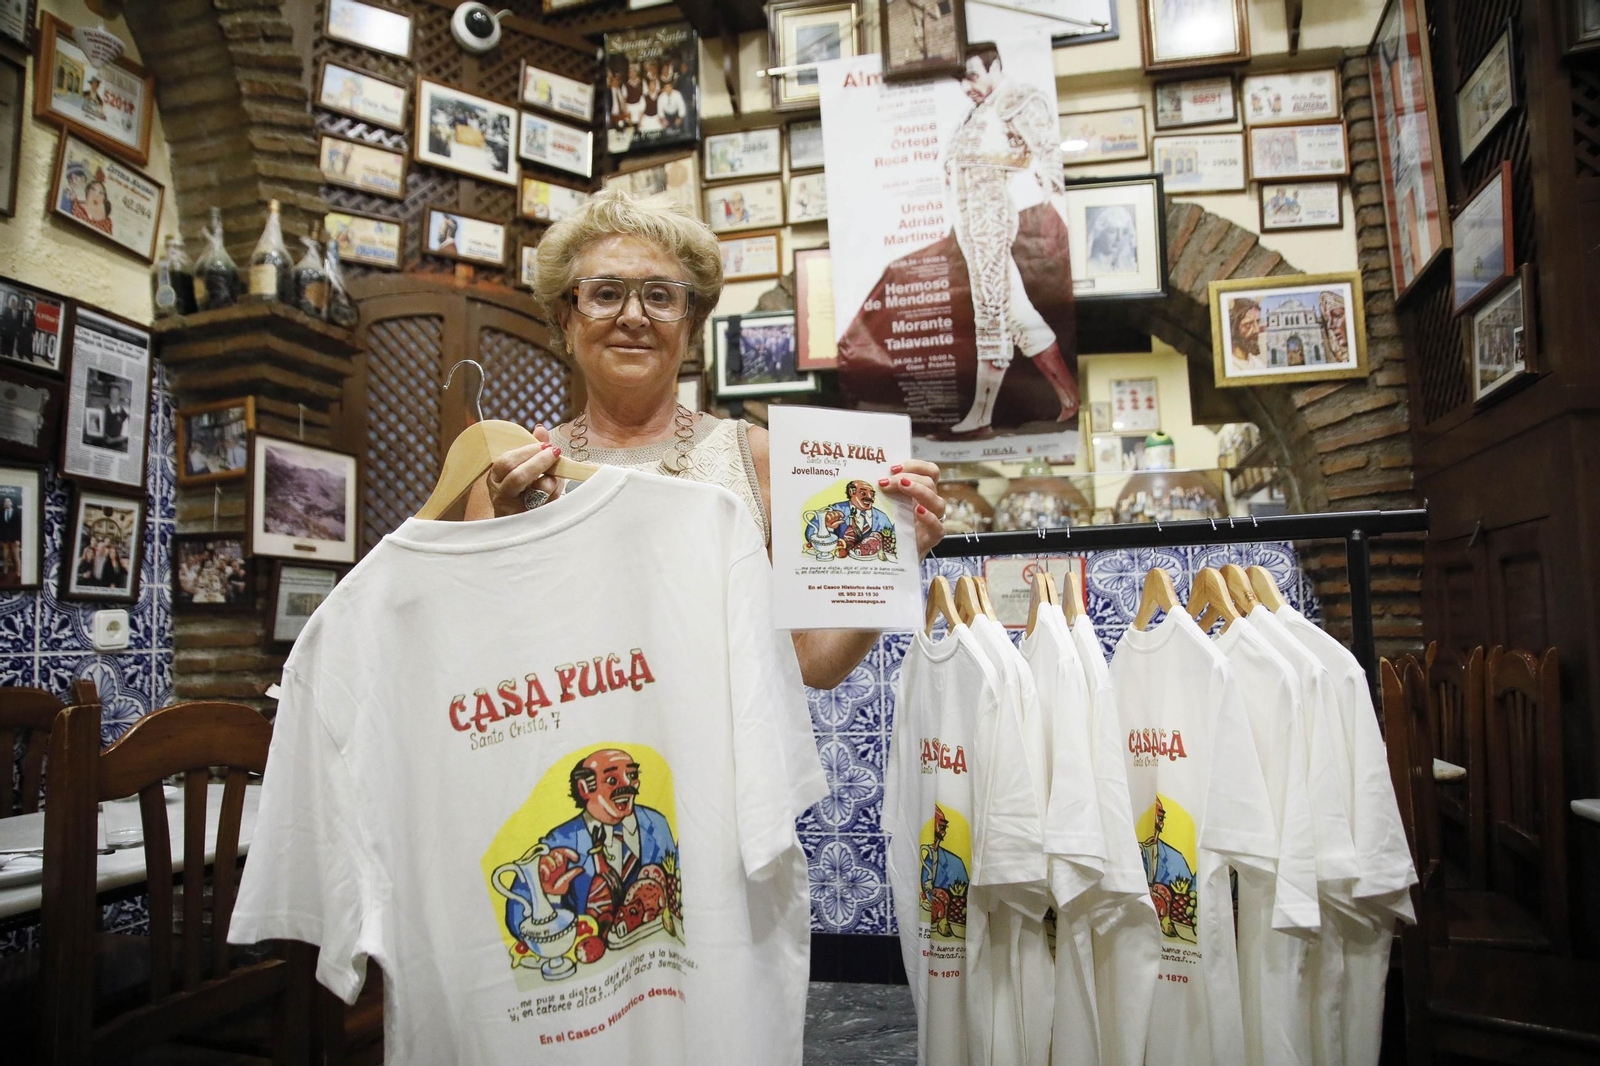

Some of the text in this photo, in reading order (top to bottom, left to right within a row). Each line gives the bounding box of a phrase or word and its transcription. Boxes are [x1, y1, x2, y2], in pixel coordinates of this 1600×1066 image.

[894, 122, 937, 136] Ponce
[891, 135, 938, 150] Ortega
[874, 150, 939, 168] Roca Rey
[885, 278, 950, 295] Hermoso
[864, 291, 951, 312] de Mendoza
[892, 316, 953, 333] Morante
[885, 333, 954, 351] Talavante
[800, 440, 887, 464] CASA PUGA
[792, 467, 840, 477] Jovellanos,7
[449, 648, 656, 733] CASA PUGA
[470, 728, 504, 751] Santo
[551, 711, 561, 729] 7
[659, 948, 665, 957] la
[941, 970, 959, 978] 1870
[1166, 974, 1188, 983] 1870
[522, 1009, 533, 1018] en
[536, 1001, 572, 1016] catorce
[634, 961, 652, 976] dos
[539, 1034, 553, 1045] En
[556, 1032, 565, 1043] el
[567, 1023, 605, 1041] Casco
[608, 994, 645, 1026] Historico
[648, 987, 677, 998] desde
